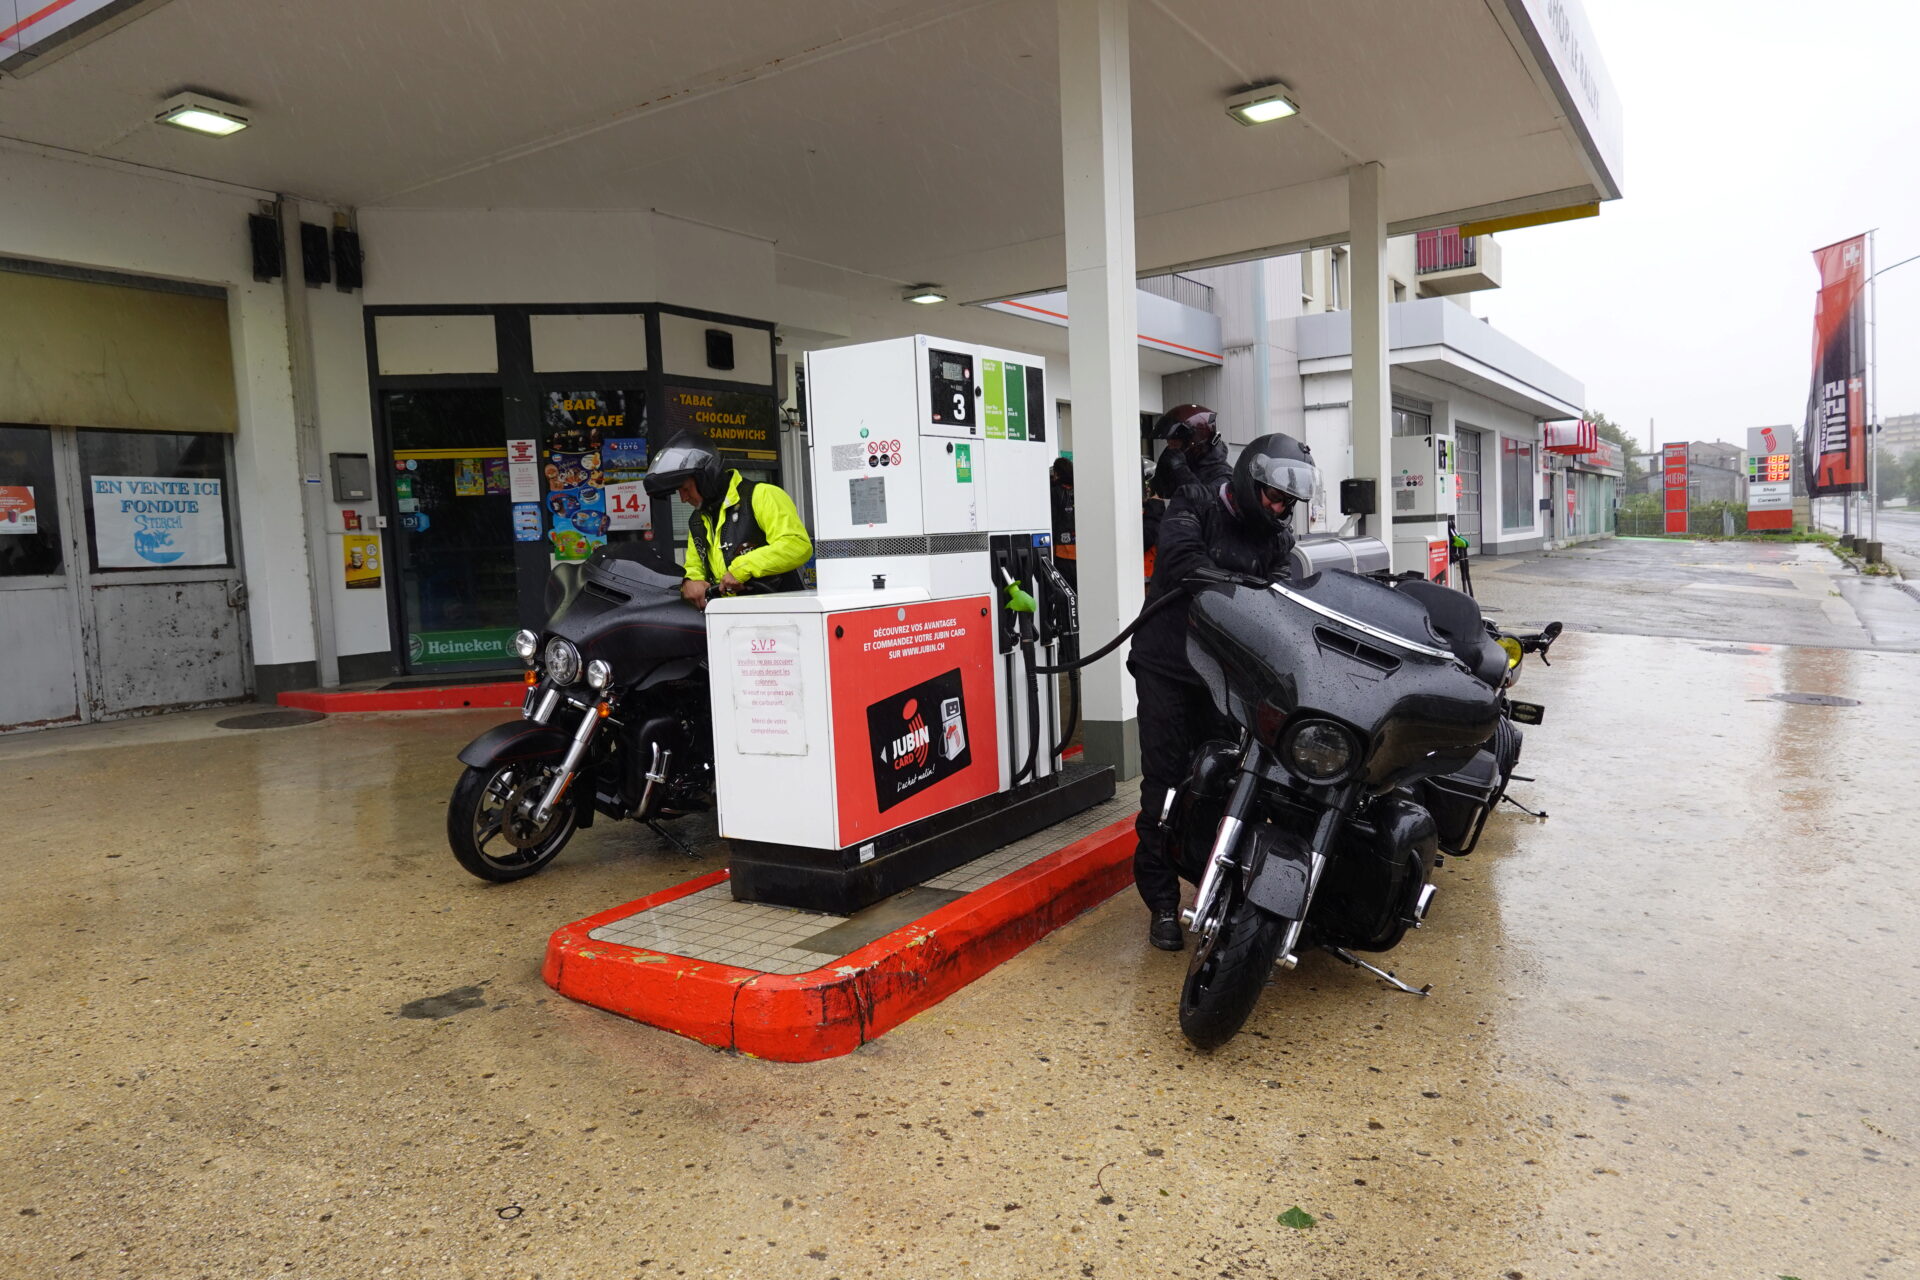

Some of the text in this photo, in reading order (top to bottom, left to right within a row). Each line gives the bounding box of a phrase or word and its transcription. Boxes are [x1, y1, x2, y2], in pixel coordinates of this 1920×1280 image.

[562, 398, 597, 412] BAR
[679, 394, 713, 407] TABAC
[952, 393, 966, 420] 3
[586, 414, 624, 427] CAFE
[696, 411, 747, 425] CHOCOLAT
[710, 428, 766, 440] SANDWICHS
[1424, 436, 1432, 448] 1
[94, 480, 220, 496] EN VENTE ICI
[120, 500, 199, 514] FONDUE
[1052, 570, 1077, 628] DIESEL
[873, 618, 957, 638] DÉCOUVREZ VOS AVANTAGES
[427, 638, 502, 654] Heineken
[752, 639, 776, 651] S.V.P
[864, 628, 966, 651] ET COMMANDEZ VOTRE JUBIN CARD
[888, 642, 945, 659] SUR WWW.JUBIN.CH
[892, 725, 930, 760] JUBIN
[894, 752, 914, 771] CARD
